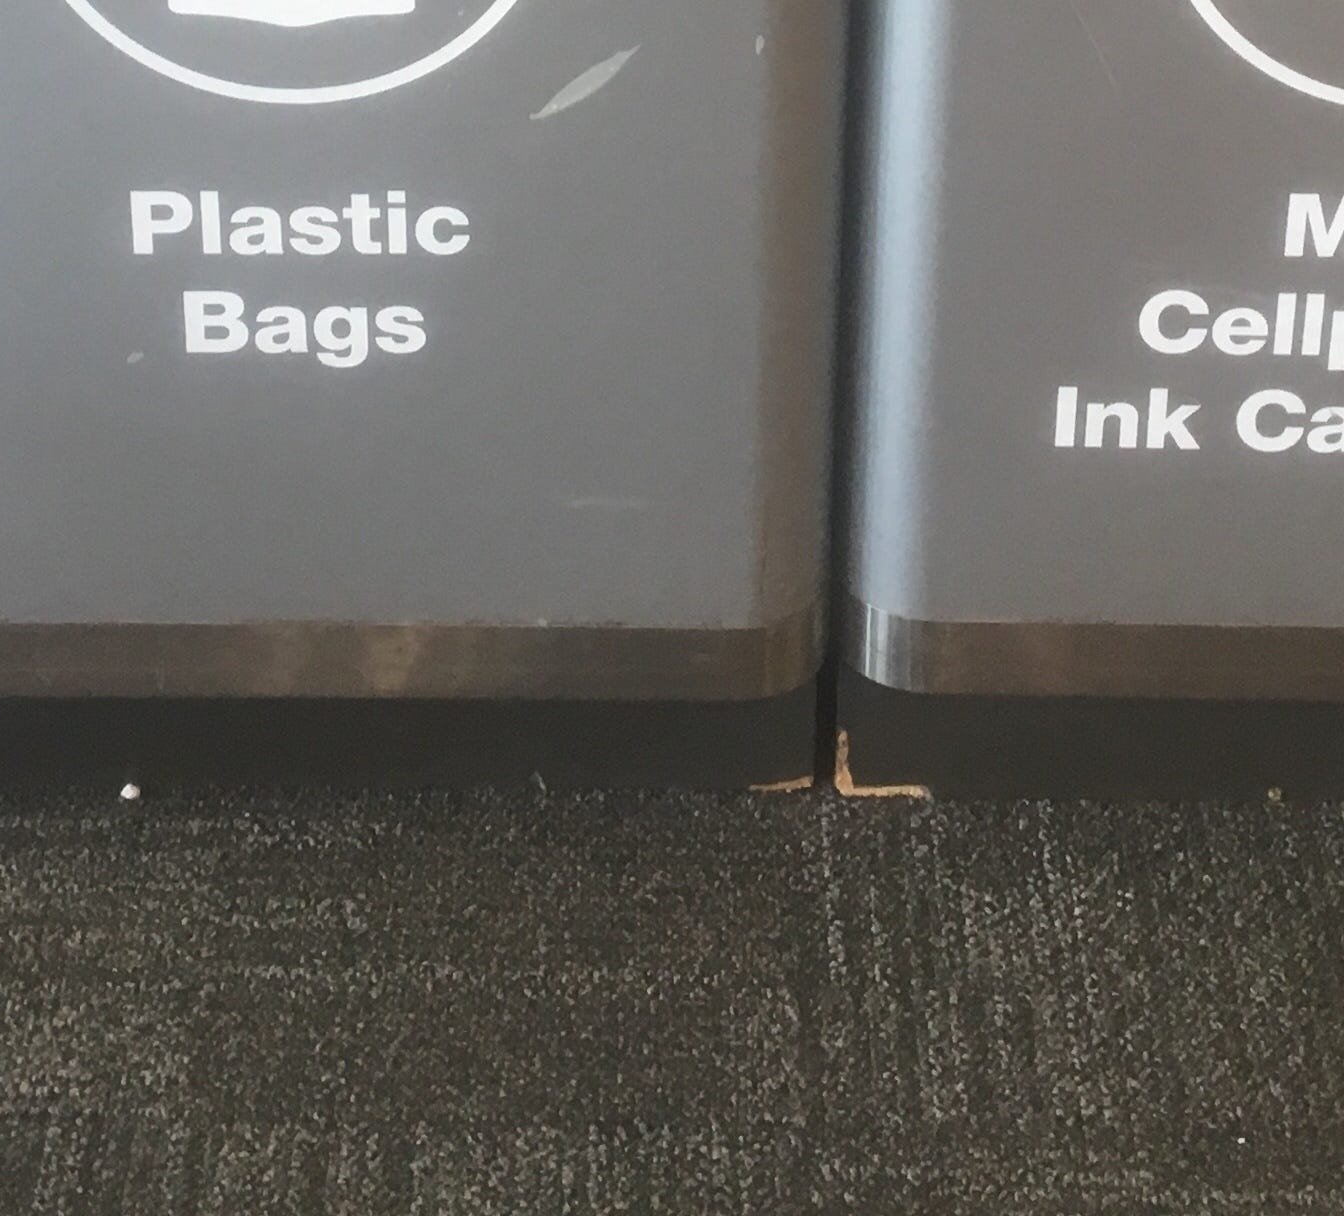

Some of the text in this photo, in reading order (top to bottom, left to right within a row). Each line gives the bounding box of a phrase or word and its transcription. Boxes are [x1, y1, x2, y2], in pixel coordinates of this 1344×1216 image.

[128, 189, 472, 256] Plastic
[181, 289, 428, 369] Bags
[1053, 384, 1202, 451] Ink
